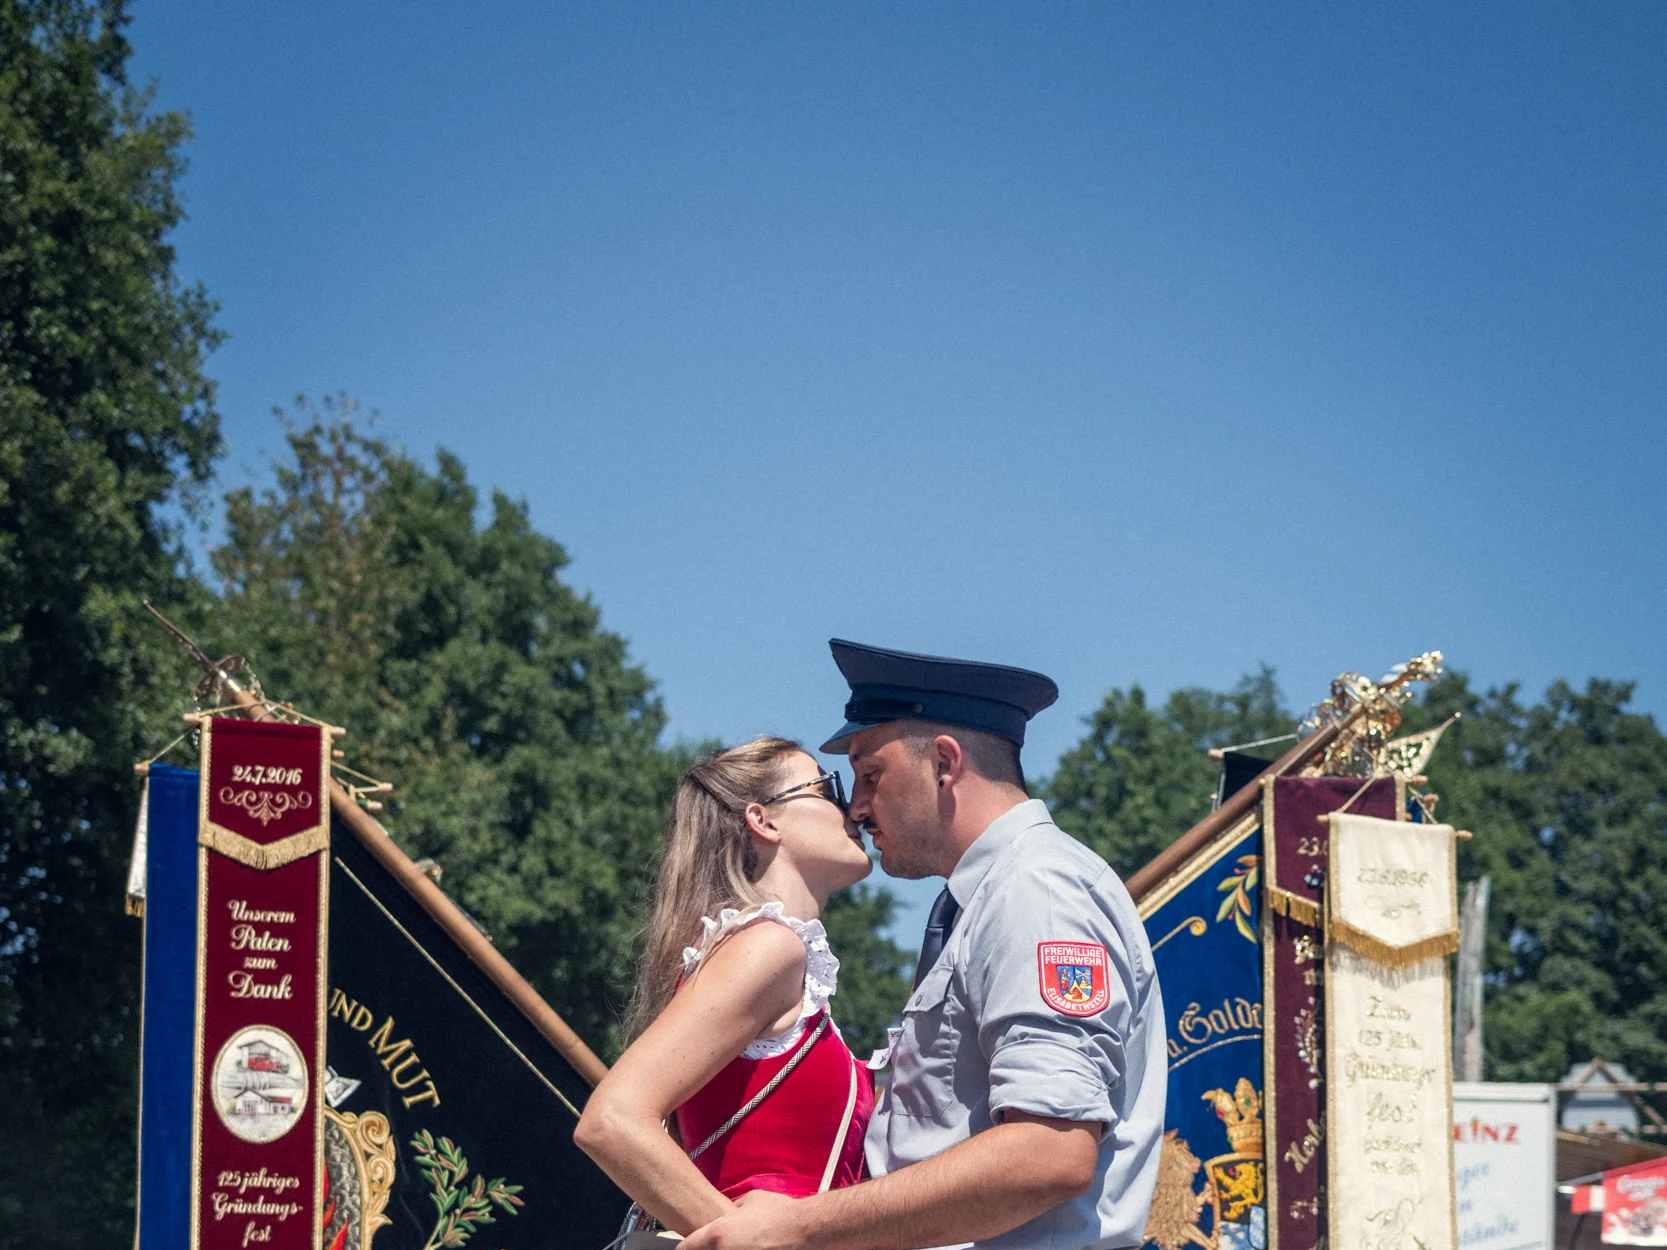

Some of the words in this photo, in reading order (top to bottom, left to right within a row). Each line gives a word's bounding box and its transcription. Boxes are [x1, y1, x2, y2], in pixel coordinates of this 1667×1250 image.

[231, 764, 303, 785] 24.7.2016
[227, 899, 297, 924] Unserem
[229, 924, 292, 952] Paten
[243, 955, 278, 970] zum
[1044, 946, 1102, 957] FREIWILLIGE
[1045, 955, 1102, 966] FEUERWEHR
[227, 970, 294, 1000] Dank
[1047, 987, 1104, 1011] ELISABETHSZELL
[368, 1015, 440, 1109] MUT
[210, 1191, 303, 1220] Gründungs-
[241, 1221, 271, 1248] fest
